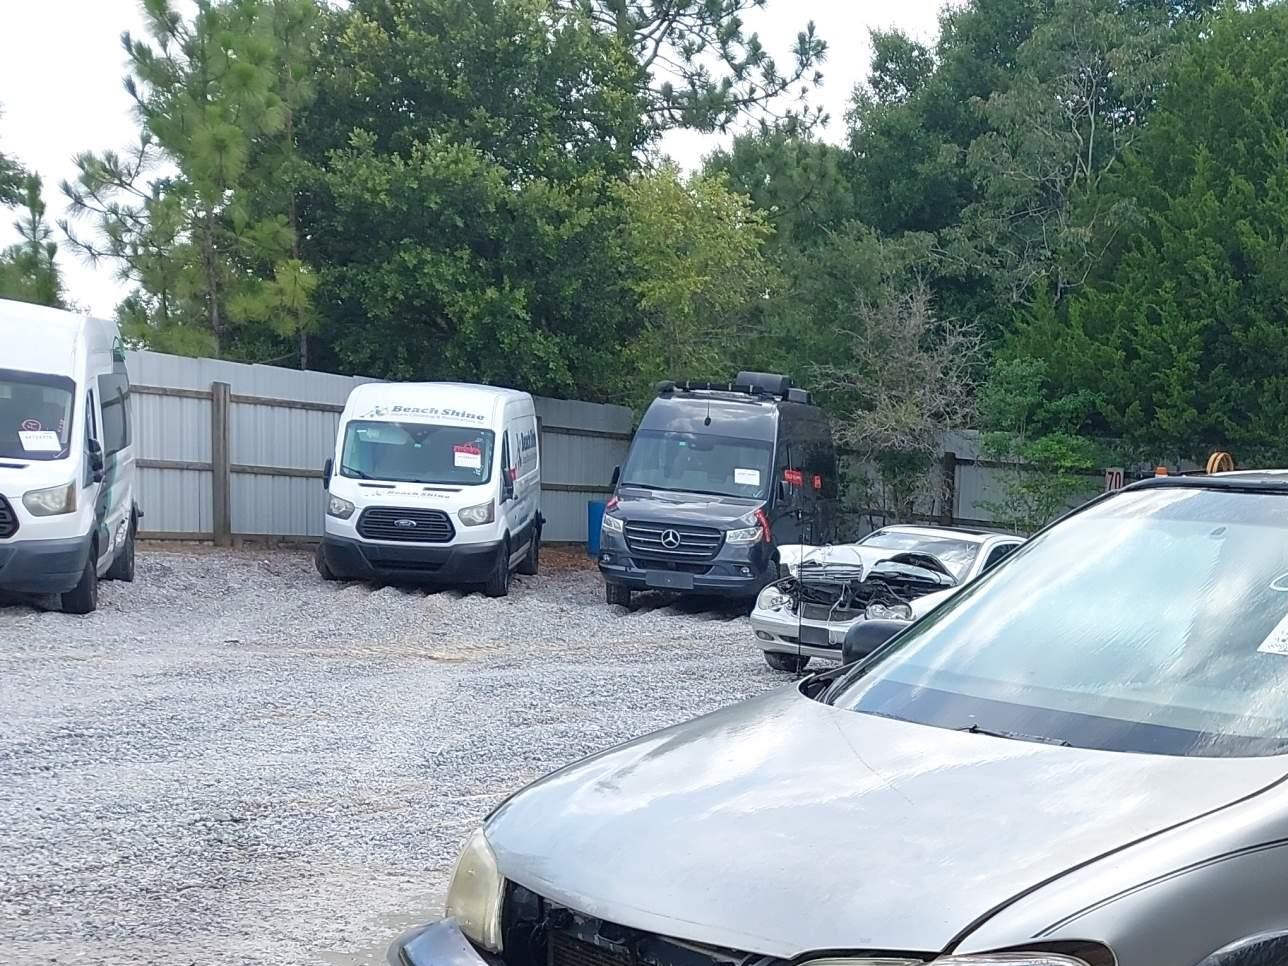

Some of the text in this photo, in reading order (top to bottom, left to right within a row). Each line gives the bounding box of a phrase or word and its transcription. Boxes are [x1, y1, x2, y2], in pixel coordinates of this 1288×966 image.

[391, 405, 439, 416] Beach
[440, 408, 485, 421] Shine
[1107, 471, 1122, 491] 70
